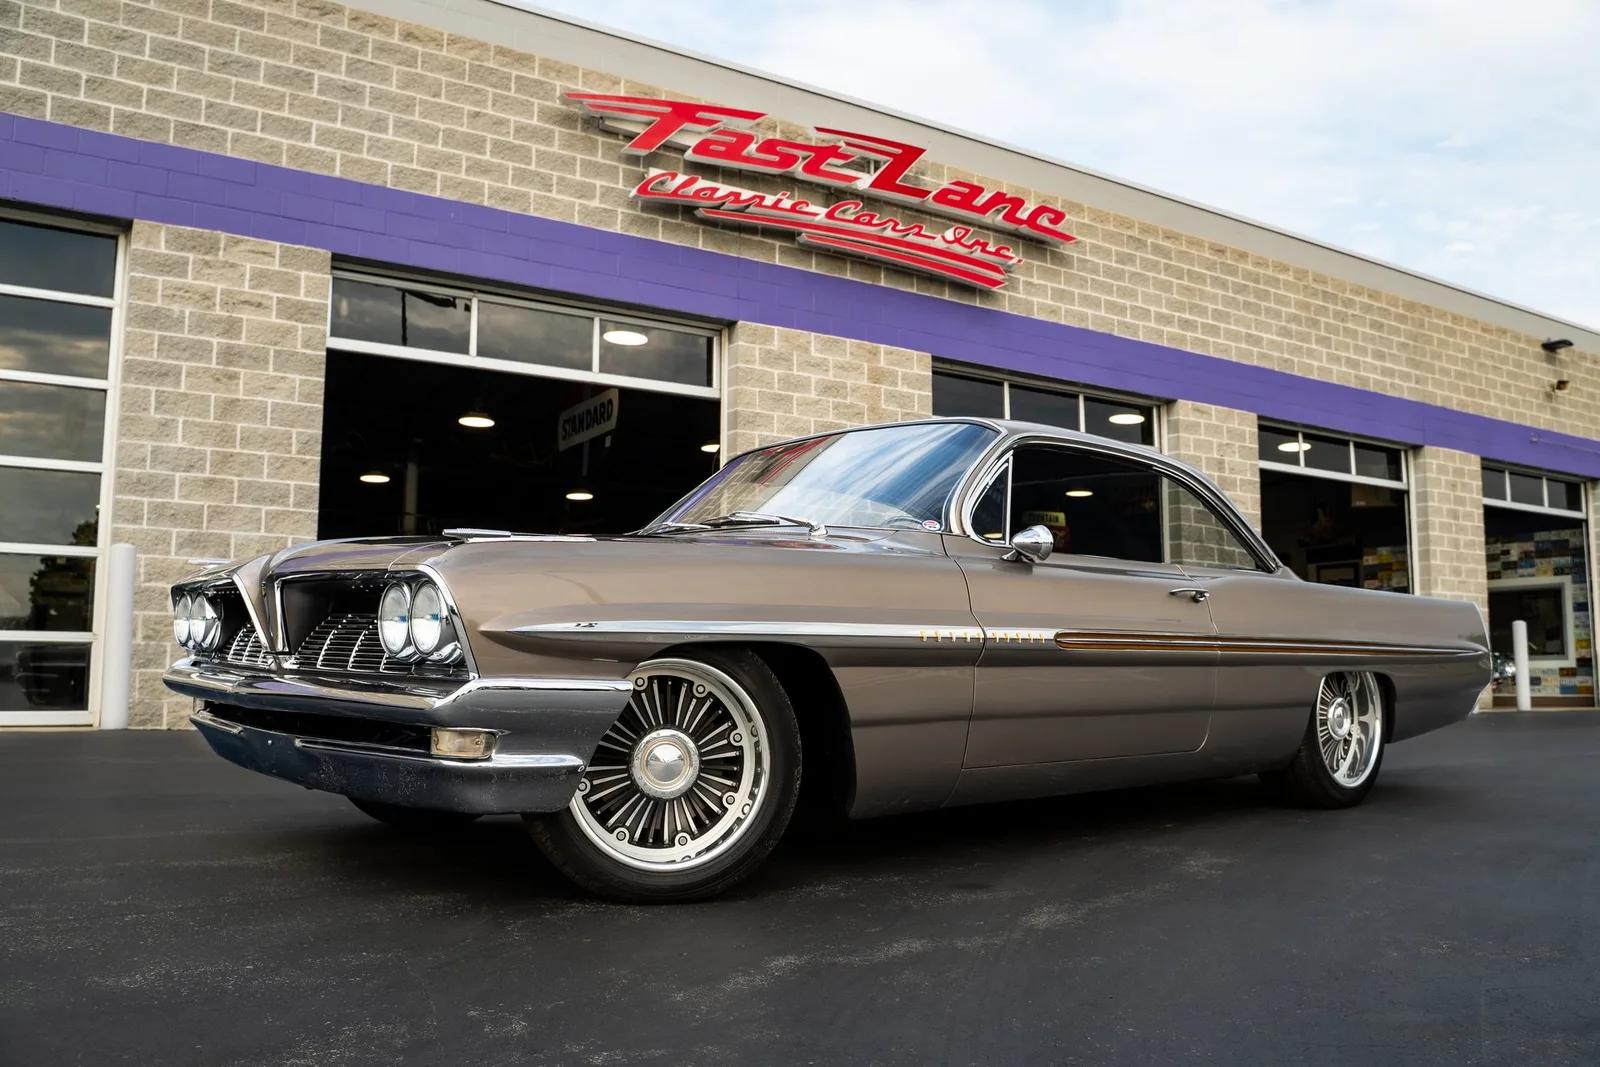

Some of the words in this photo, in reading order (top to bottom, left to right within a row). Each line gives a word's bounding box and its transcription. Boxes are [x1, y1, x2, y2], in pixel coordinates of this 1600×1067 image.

[564, 92, 861, 184] Fast
[814, 126, 1077, 244] Lane
[636, 172, 820, 218] Classic
[824, 201, 937, 240] Cars
[562, 398, 613, 440] STANDARD
